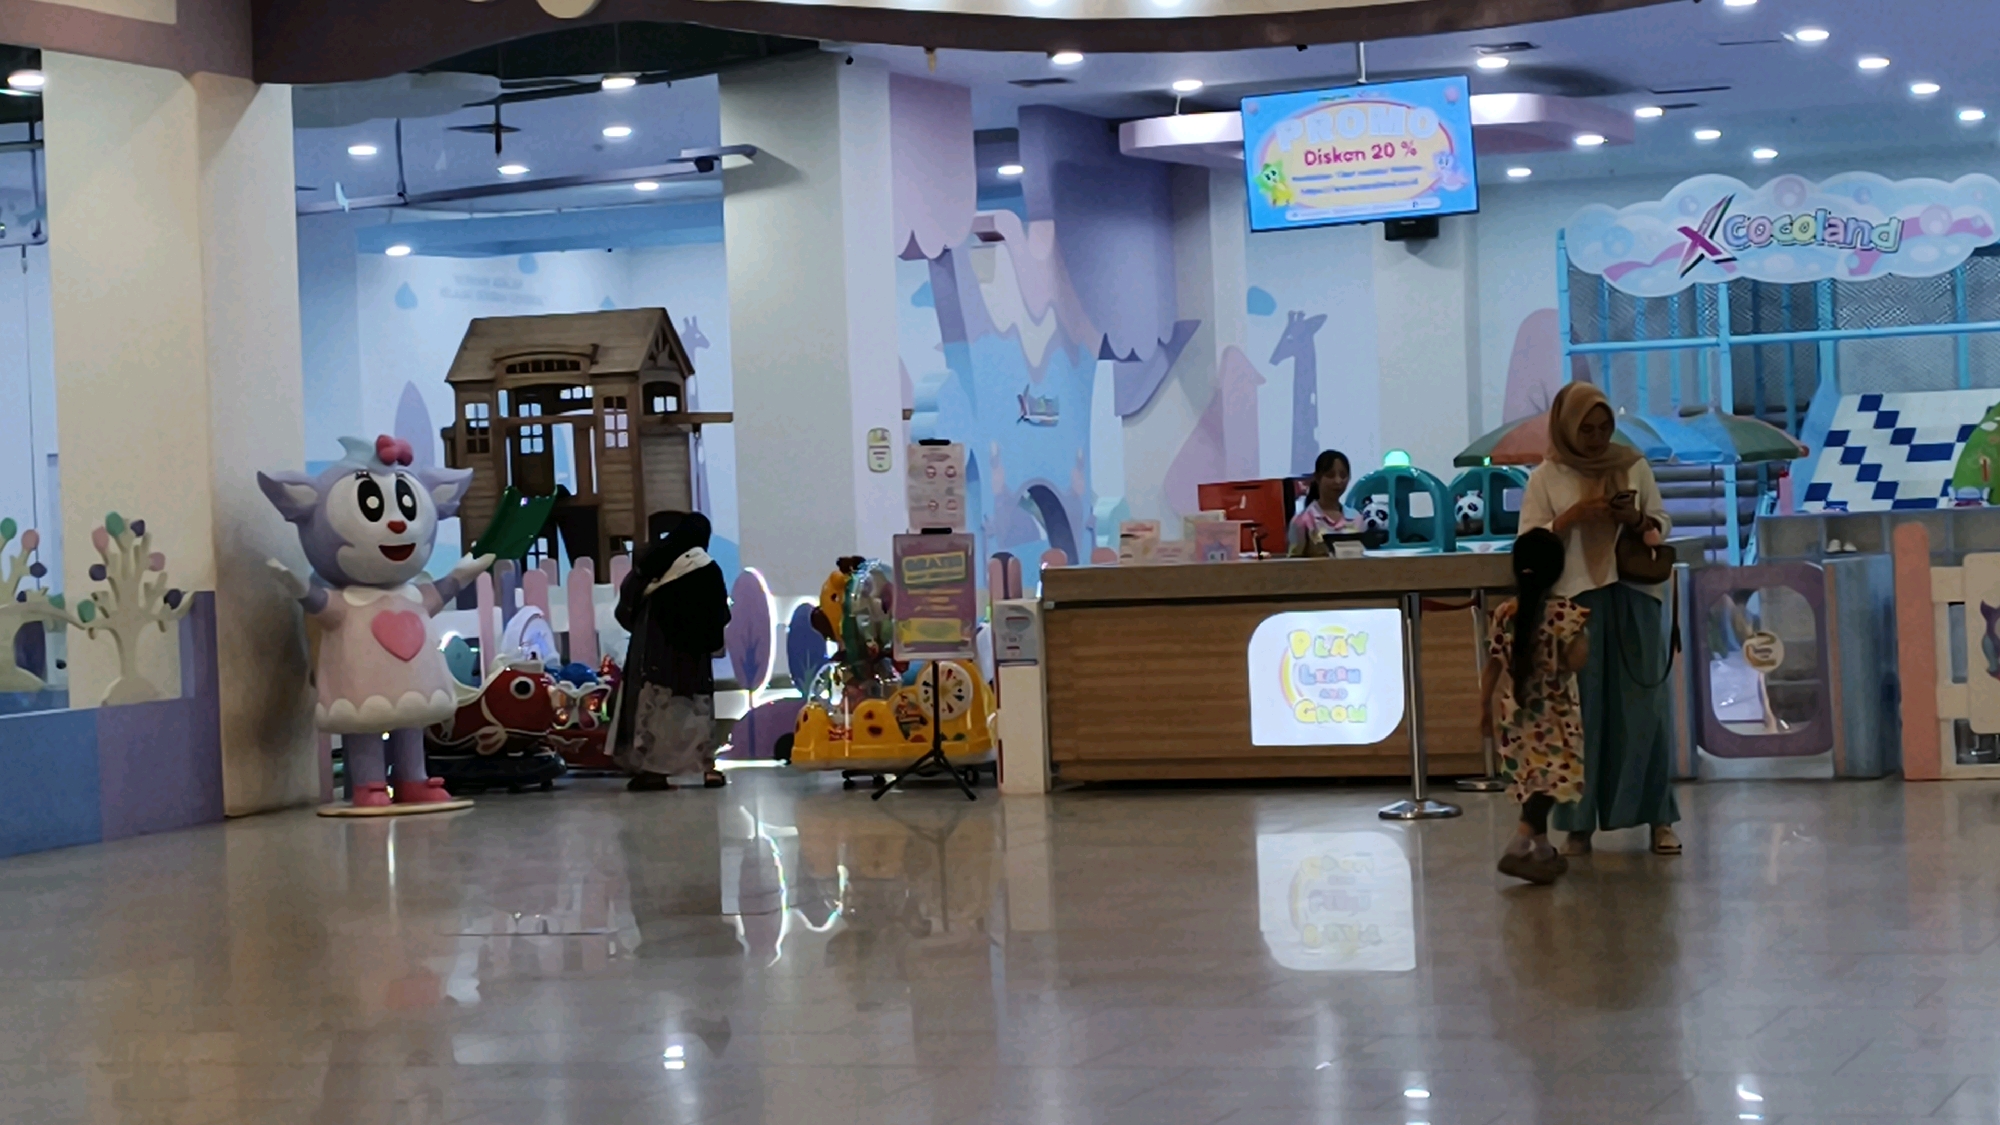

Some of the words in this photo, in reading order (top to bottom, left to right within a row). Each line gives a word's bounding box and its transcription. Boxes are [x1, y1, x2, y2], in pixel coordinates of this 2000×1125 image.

[1276, 105, 1439, 153] PROMO
[1304, 147, 1366, 166] Diskon
[1371, 142, 1395, 160] 20
[1400, 140, 1418, 158] %
